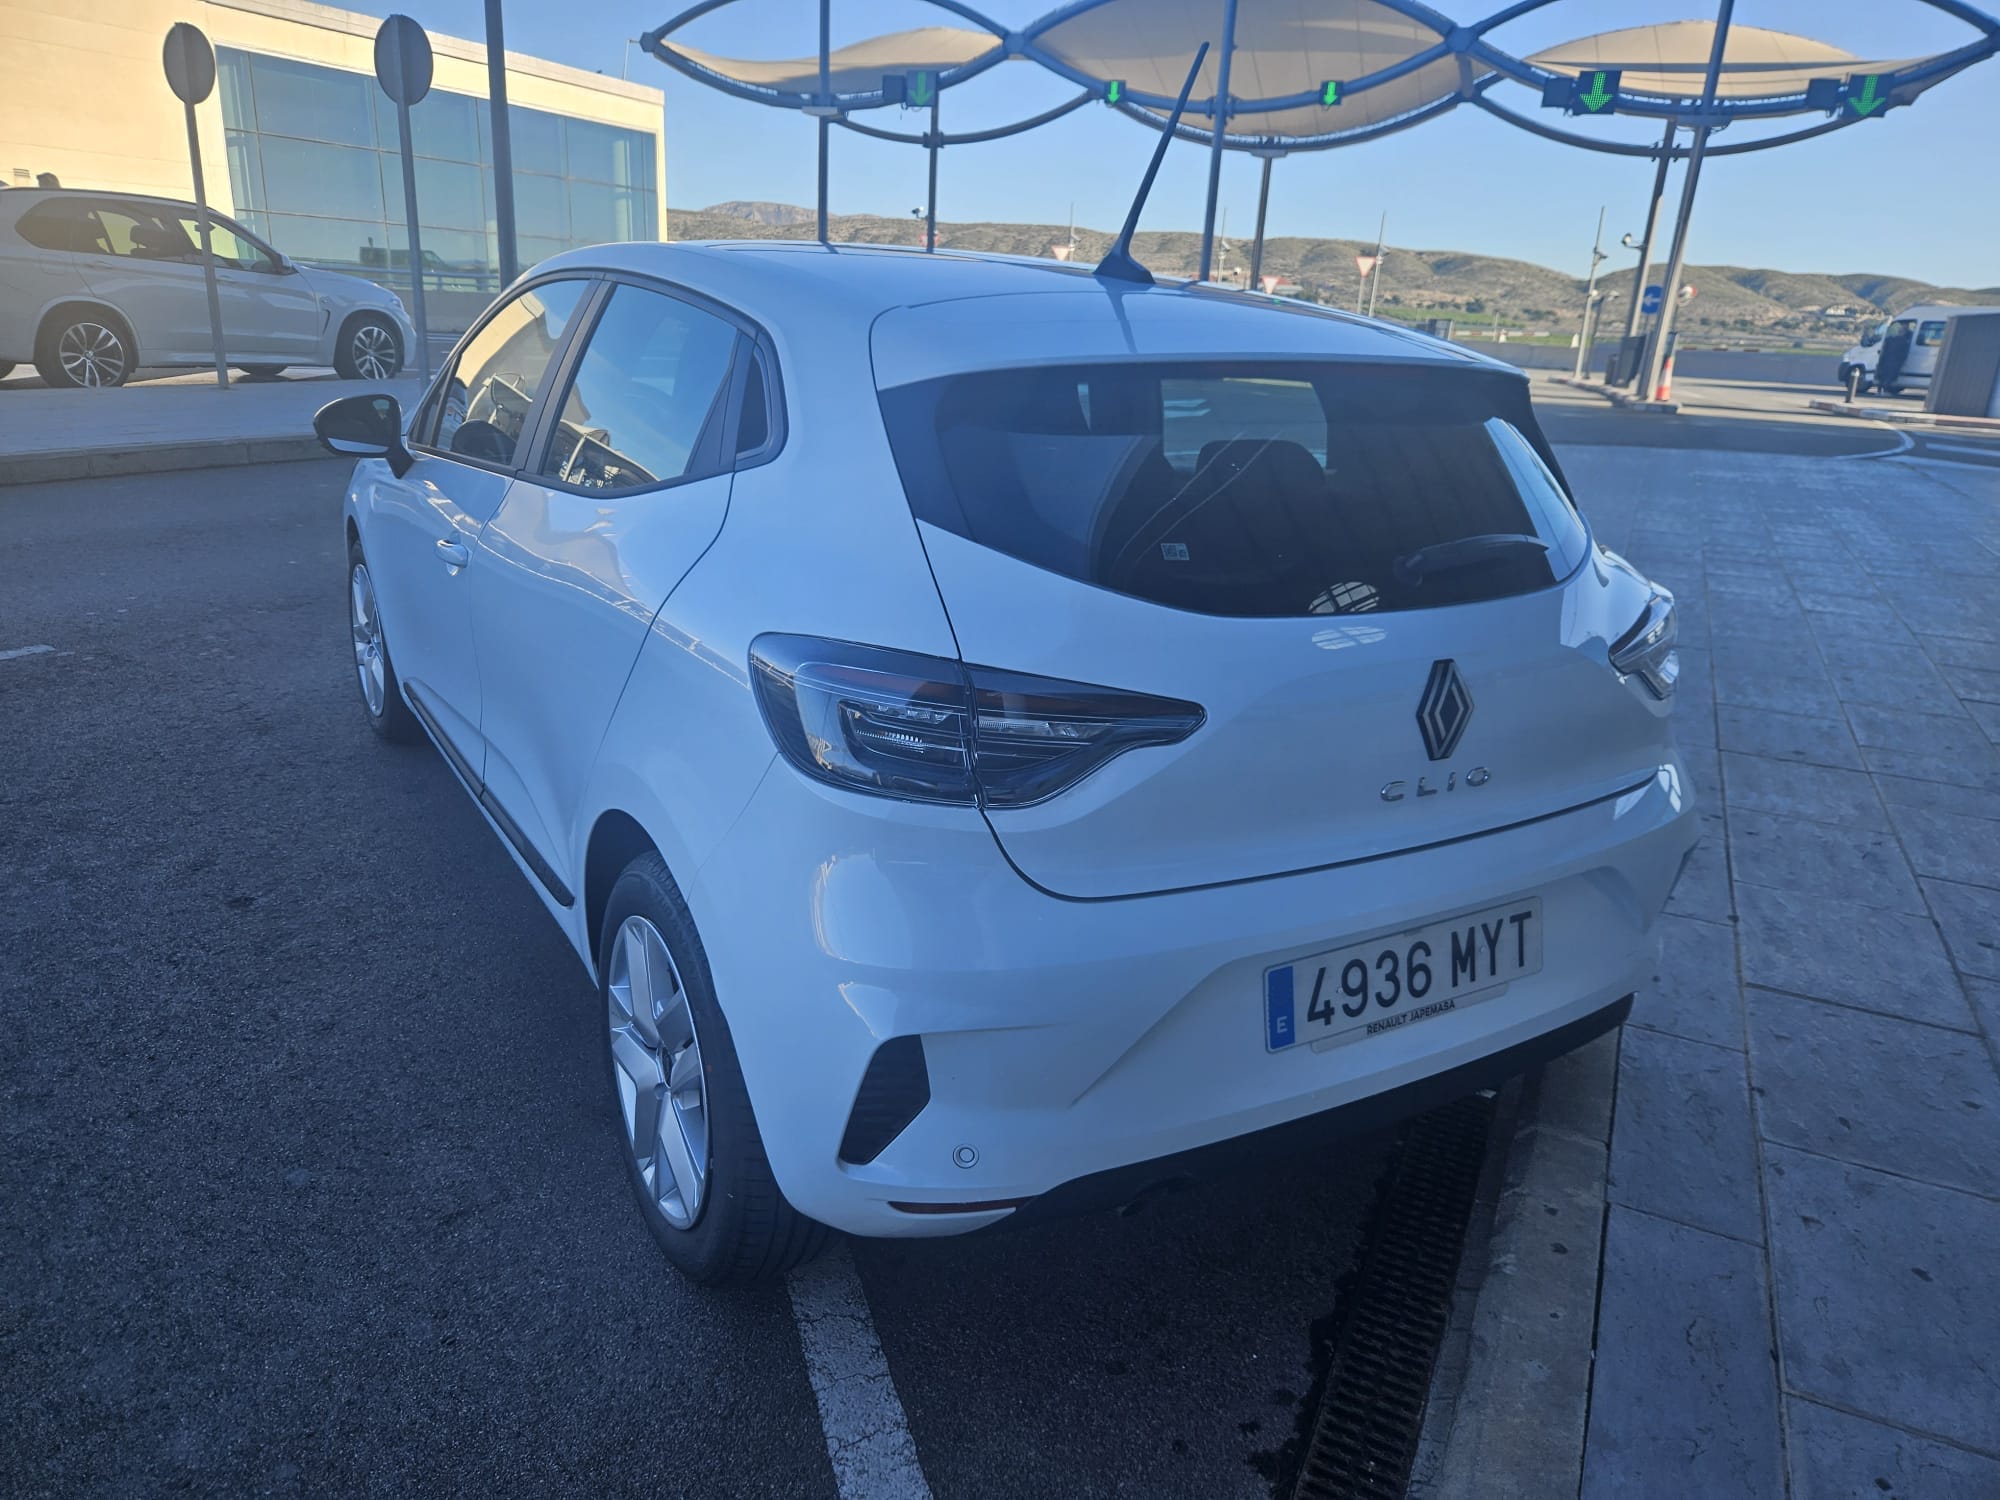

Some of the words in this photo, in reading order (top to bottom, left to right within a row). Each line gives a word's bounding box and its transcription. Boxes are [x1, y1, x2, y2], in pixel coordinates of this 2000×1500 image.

[1380, 766, 1491, 802] CLIO
[1306, 940, 1432, 1027] 4936
[1451, 910, 1532, 988] MYT
[1276, 1016, 1288, 1034] E
[1366, 1013, 1407, 1036] RENAULT
[1408, 999, 1456, 1024] JAPEMASA
